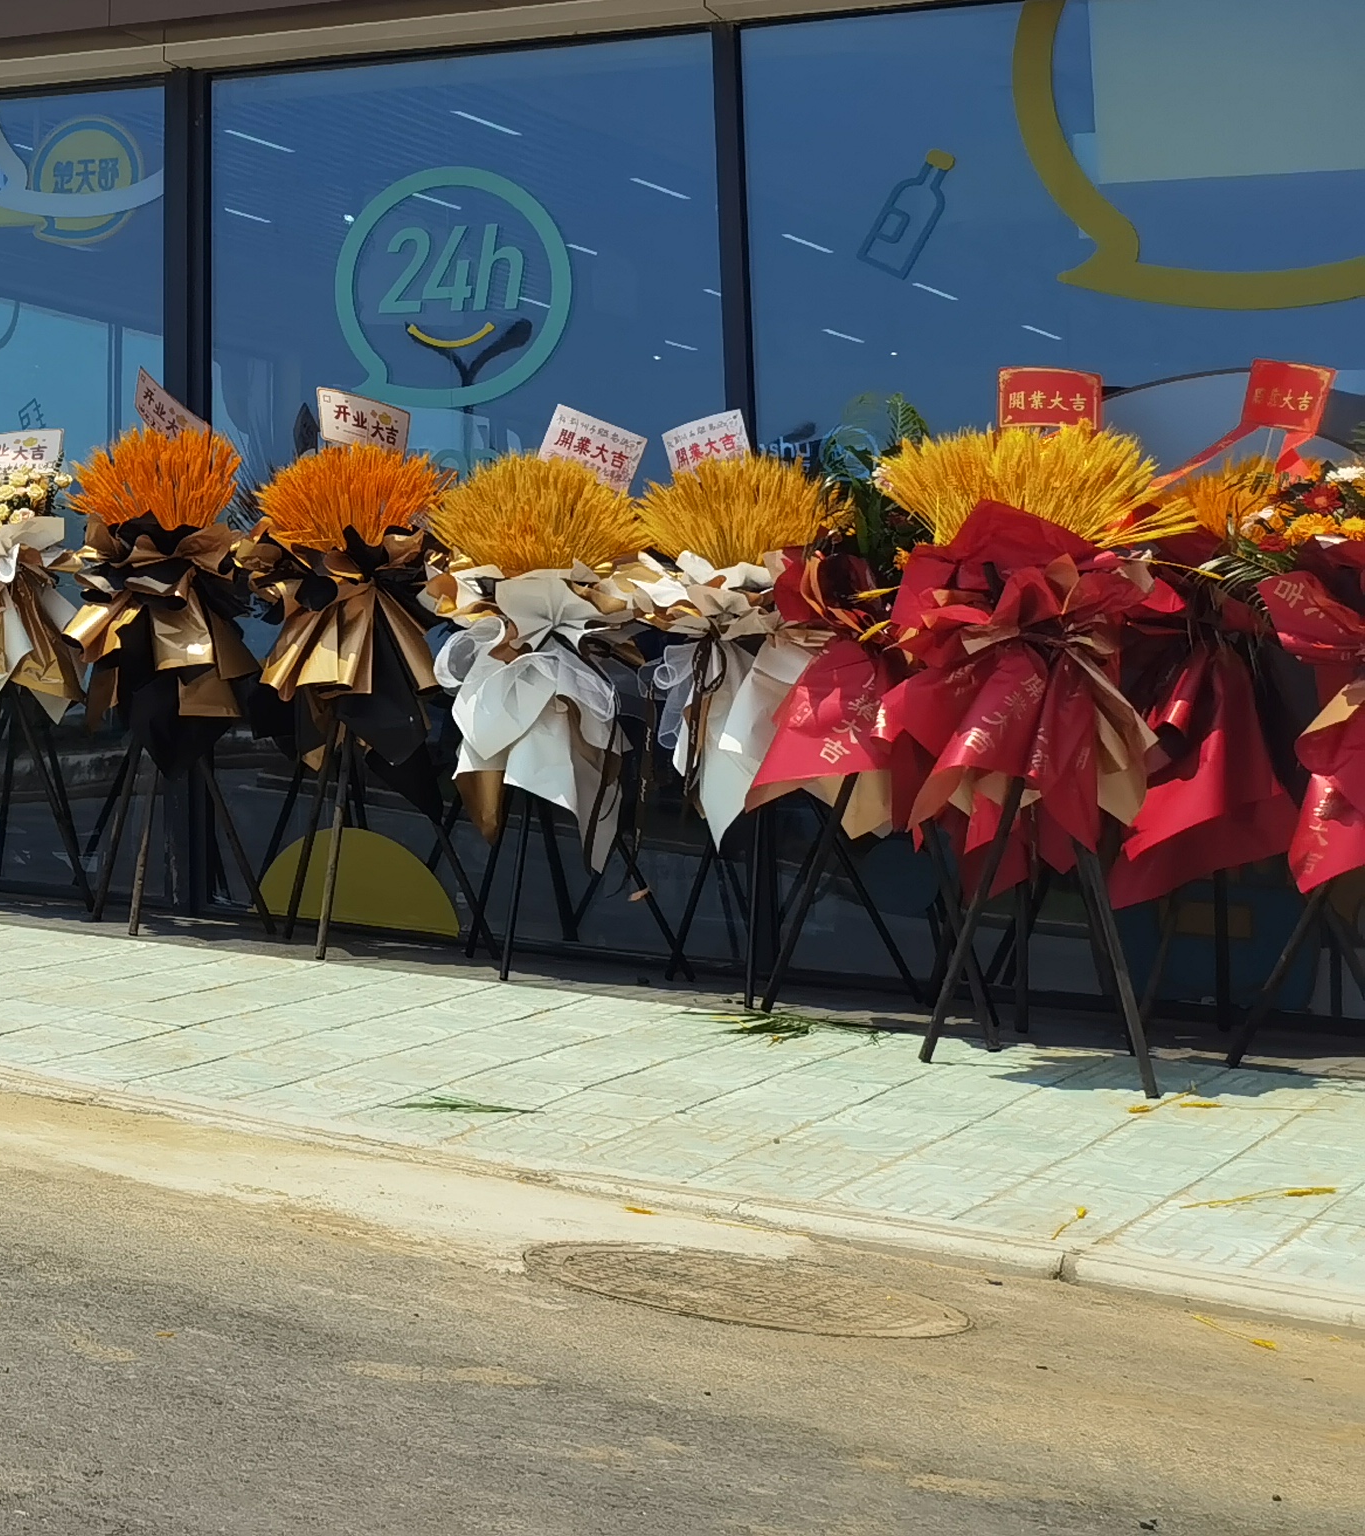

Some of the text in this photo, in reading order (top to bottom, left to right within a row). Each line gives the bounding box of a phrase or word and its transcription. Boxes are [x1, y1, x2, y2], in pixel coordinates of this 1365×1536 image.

[377, 222, 526, 316] 24h
[142, 386, 186, 440] 开业大
[1008, 389, 1088, 413] 開業大吉
[332, 403, 400, 447] 开业大吉
[553, 428, 630, 470] 開業大吉
[674, 432, 737, 470] 開業大吉
